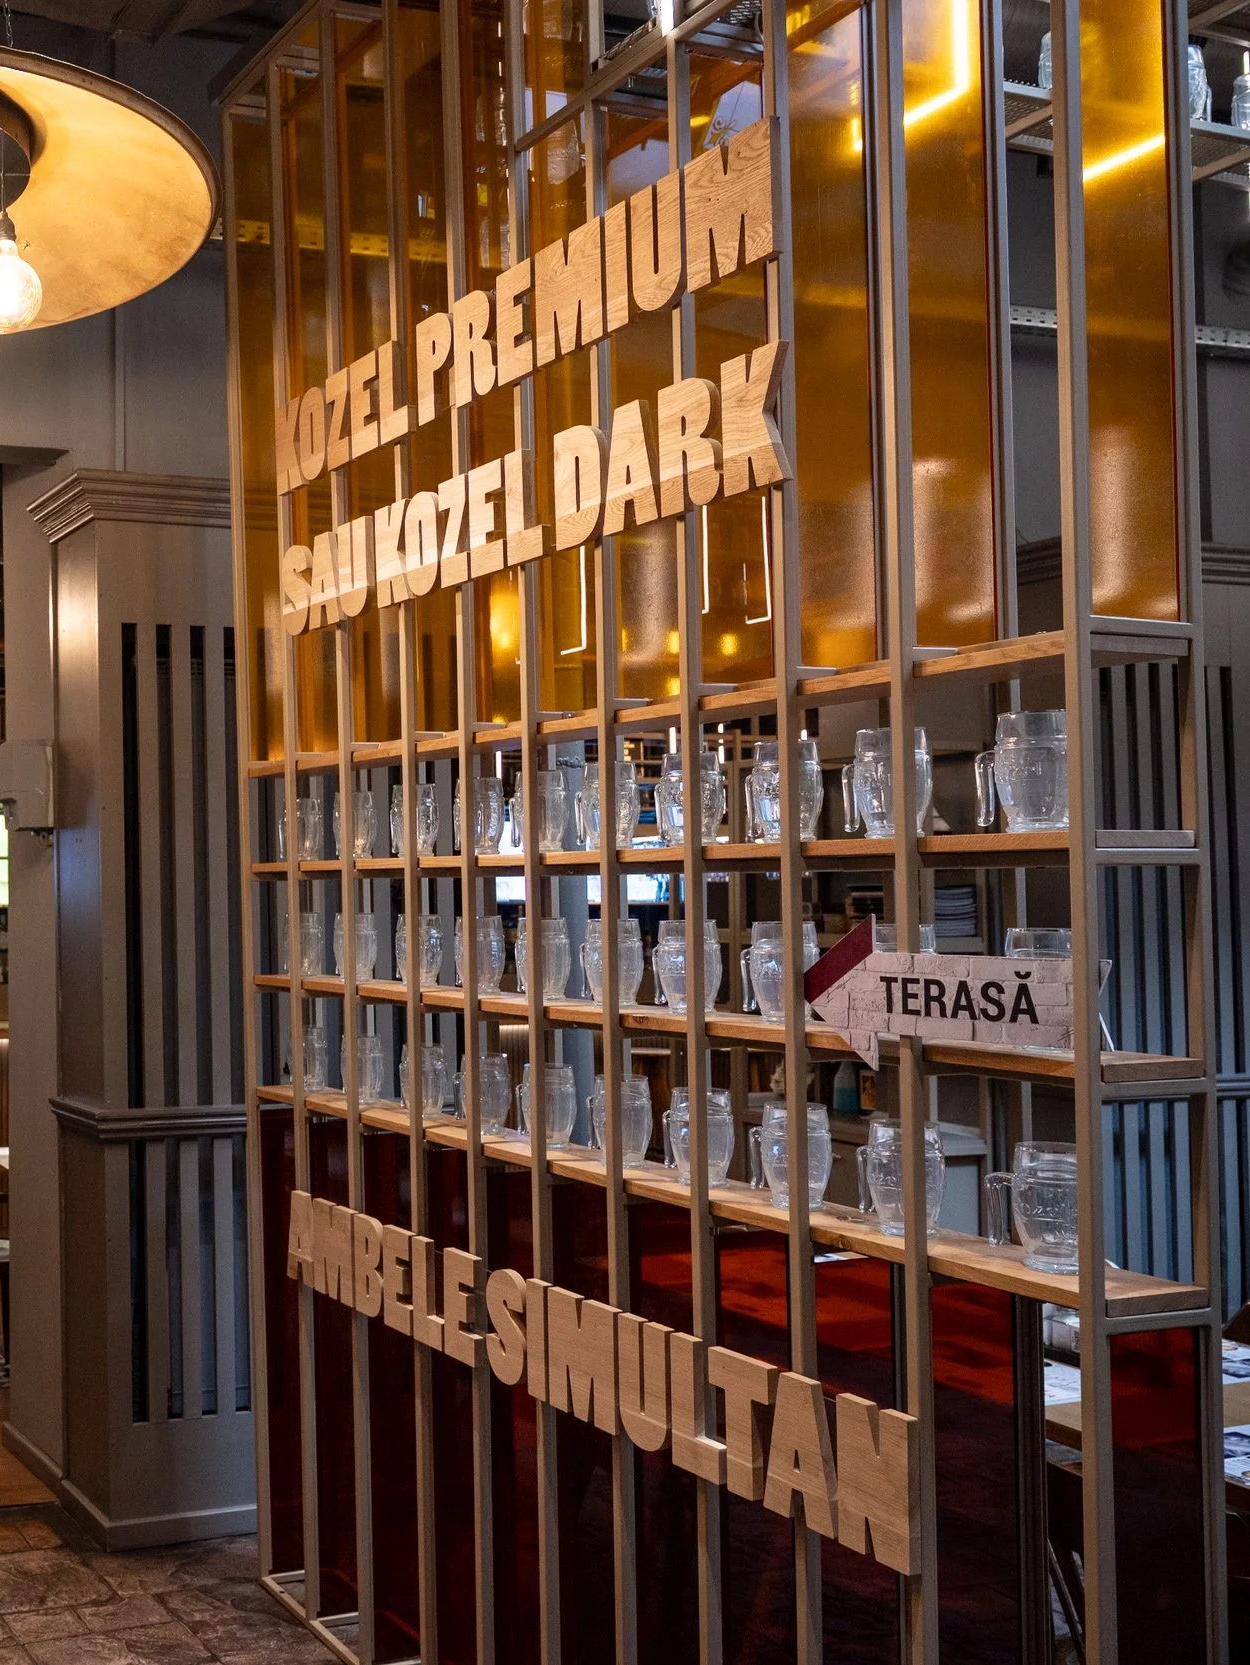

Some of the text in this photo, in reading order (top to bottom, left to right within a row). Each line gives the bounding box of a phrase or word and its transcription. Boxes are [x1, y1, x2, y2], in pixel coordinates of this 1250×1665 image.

[275, 115, 782, 496] KOZEL PREMIUM
[282, 339, 794, 637] SAU KOZEL DARK
[879, 971, 1040, 1025] TERASĂ
[286, 1190, 922, 1577] AMBELE SIMULTAN
